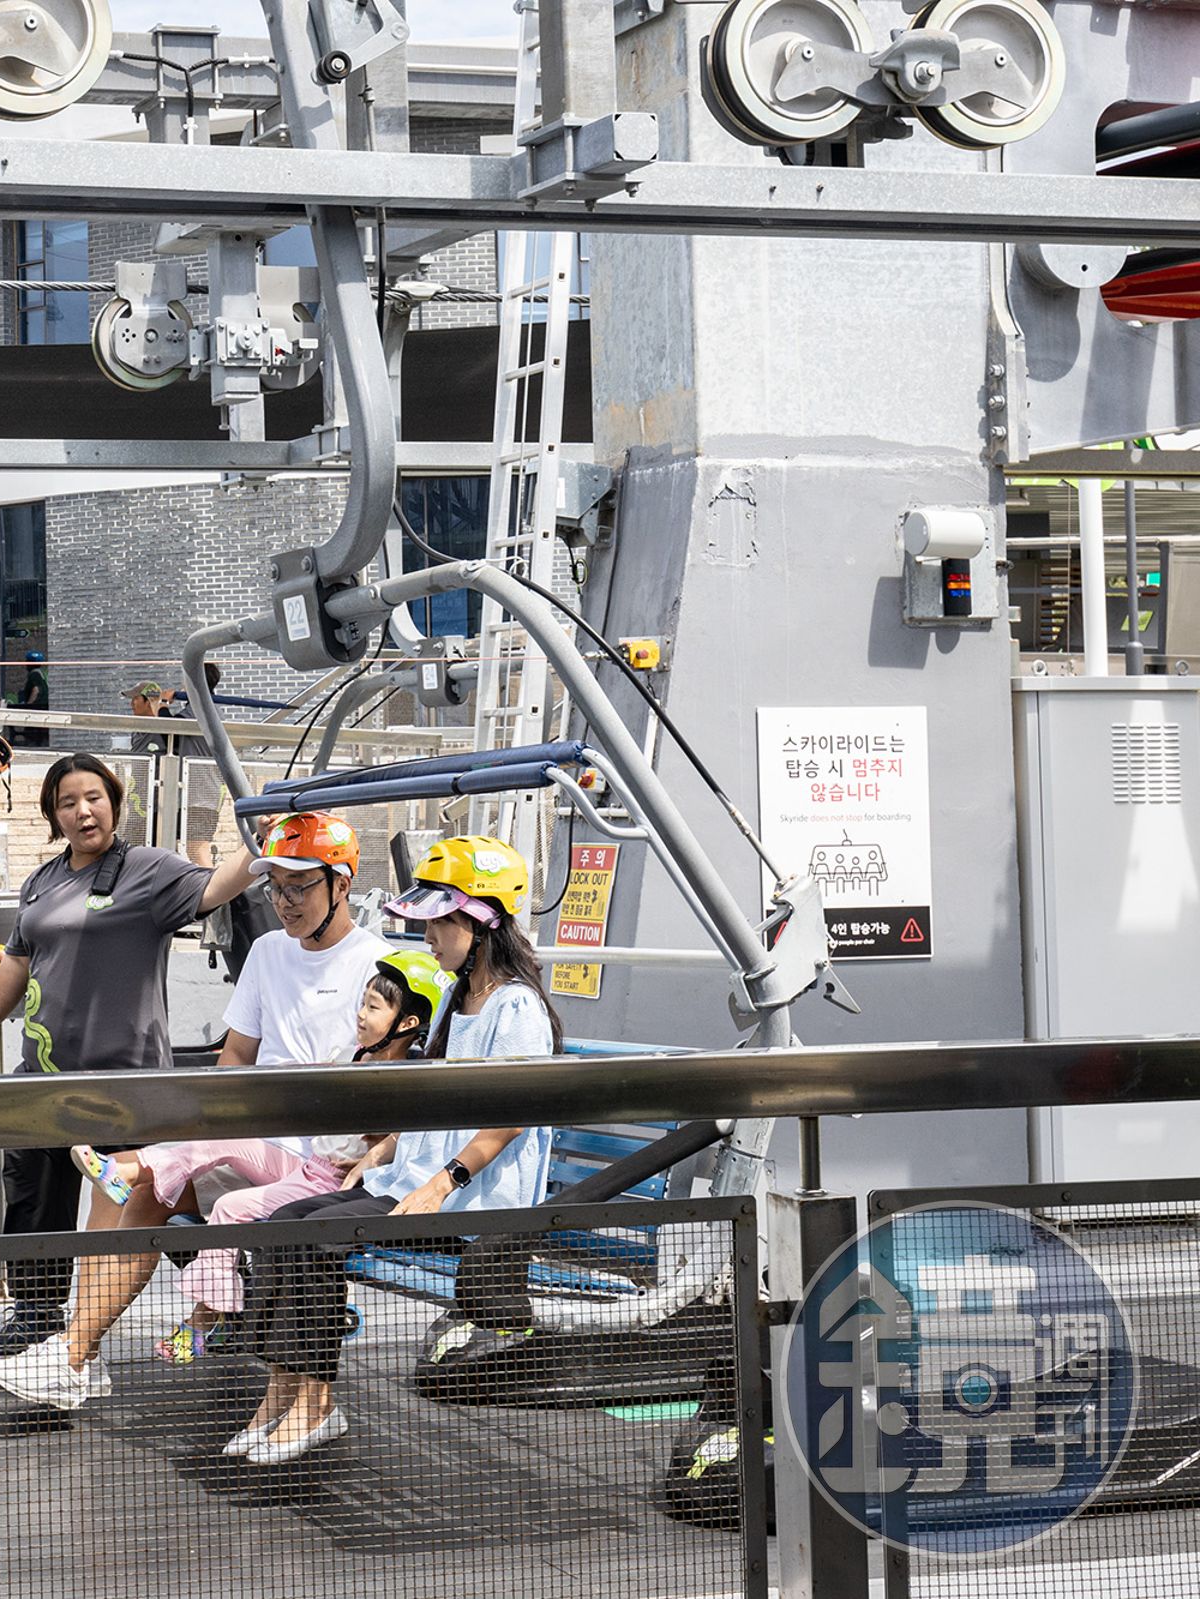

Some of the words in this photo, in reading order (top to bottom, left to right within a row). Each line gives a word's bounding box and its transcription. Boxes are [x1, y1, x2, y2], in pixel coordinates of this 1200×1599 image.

[287, 600, 305, 625] 22
[782, 735, 905, 754] 스카이라이드는
[785, 759, 820, 779] 탑승
[828, 758, 843, 778] 시
[852, 758, 902, 778] 멈추지
[810, 782, 880, 802] 않습니다
[779, 814, 809, 824] Skyride
[810, 814, 829, 822] does
[831, 814, 845, 822] not
[846, 813, 863, 824] stop
[864, 812, 875, 821] for
[876, 812, 912, 823] boarding
[580, 850, 590, 867] 주
[595, 850, 606, 867] 의
[569, 872, 590, 885] LOCK
[591, 873, 609, 886] OUT
[561, 924, 600, 942] CAUTION
[831, 922, 847, 935] 4인
[850, 921, 891, 936] 탑승가능
